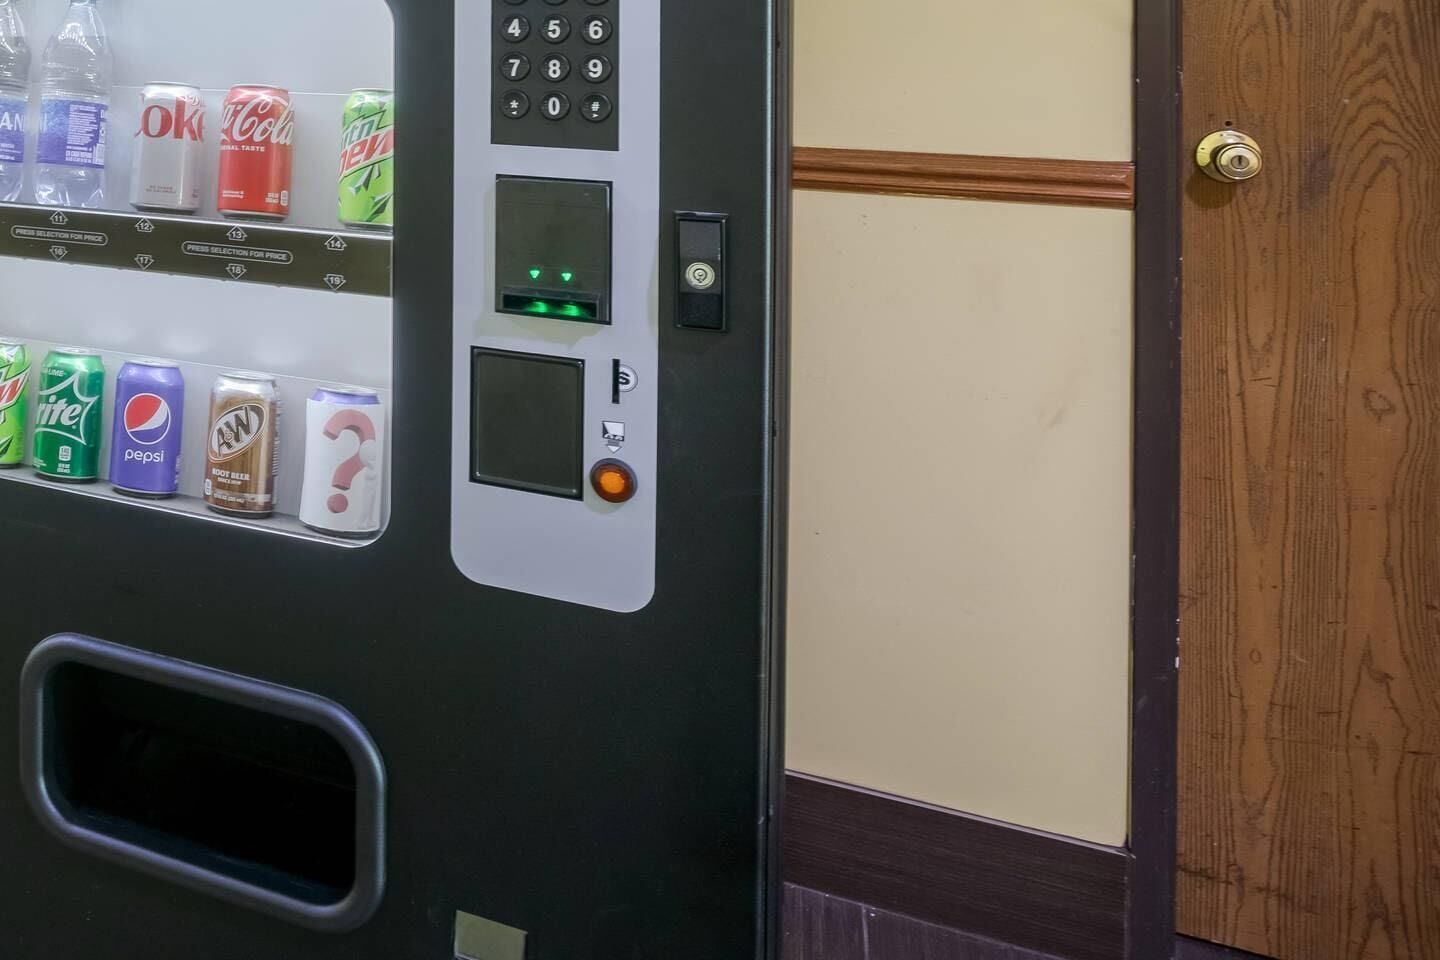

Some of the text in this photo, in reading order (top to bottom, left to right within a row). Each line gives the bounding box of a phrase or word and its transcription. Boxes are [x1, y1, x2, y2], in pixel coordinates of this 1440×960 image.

[507, 18, 603, 39] 4 5 6
[508, 58, 603, 78] 7 8 9
[547, 97, 560, 116] 0
[241, 145, 265, 153] TASTE
[54, 215, 64, 223] 11
[139, 222, 149, 231] 12
[15, 228, 103, 242] PRESS SELECTION FOR PRICE
[231, 230, 242, 239] 13
[330, 240, 341, 248] 14
[54, 247, 64, 256] 16
[186, 243, 288, 261] PRESS SELECTION FOR PRICE
[139, 256, 150, 265] 17
[231, 266, 241, 274] 18
[329, 276, 340, 285] 19
[124, 449, 164, 464] pepsi
[322, 409, 376, 514] ?
[212, 468, 250, 481] ROOT BEER
